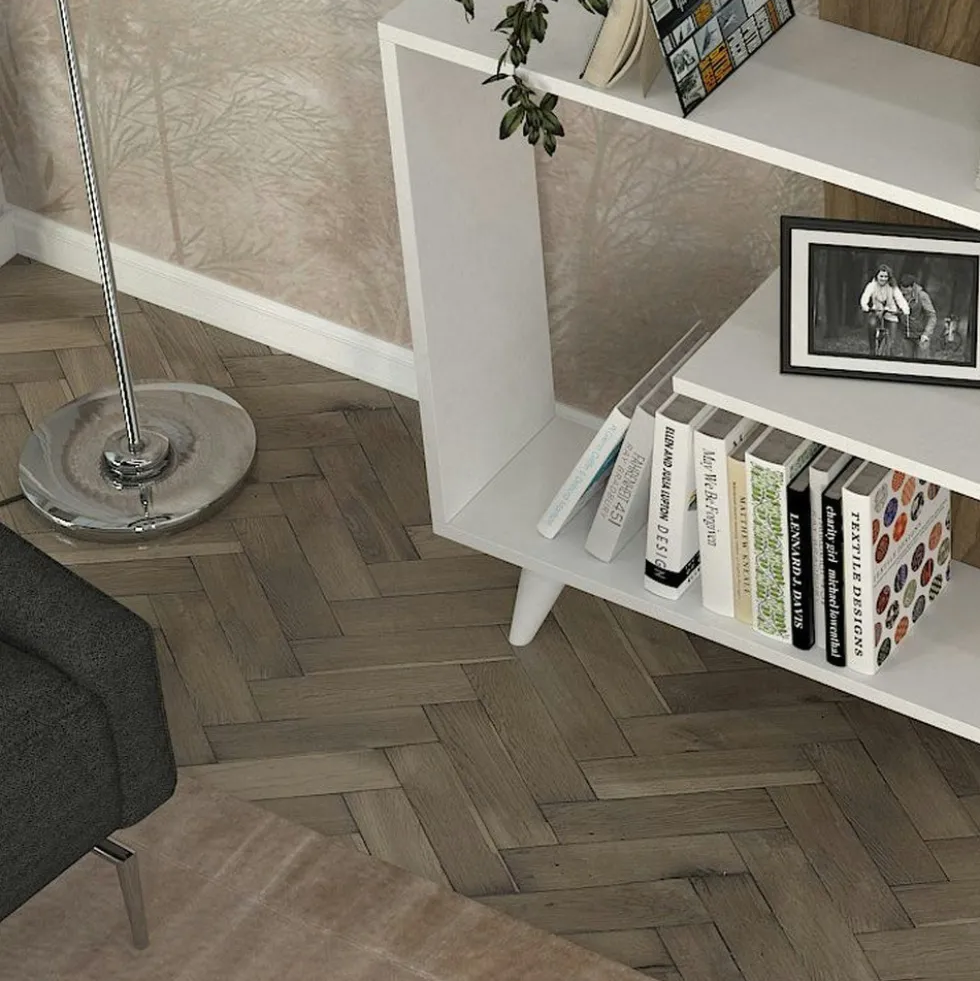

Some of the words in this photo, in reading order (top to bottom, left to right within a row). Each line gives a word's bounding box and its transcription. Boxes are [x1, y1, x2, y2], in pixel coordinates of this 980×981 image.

[664, 426, 676, 448] ELLEN
[662, 449, 674, 467] AND
[700, 448, 716, 470] May
[660, 467, 673, 489] JULIA
[702, 471, 717, 488] We
[704, 488, 718, 505] Be
[658, 489, 671, 521] LUPTON
[739, 497, 750, 549] MATTHEW
[702, 502, 718, 547] Forgiven
[790, 513, 803, 574] LENNARD
[825, 506, 836, 543] charity
[652, 524, 669, 580] DESIGN
[825, 542, 838, 562] girl
[851, 511, 862, 582] TEXTILE
[828, 568, 839, 607] michael
[793, 589, 804, 629] DAVIS
[853, 585, 864, 657] DESIGNS
[829, 608, 842, 657] lowenthal
